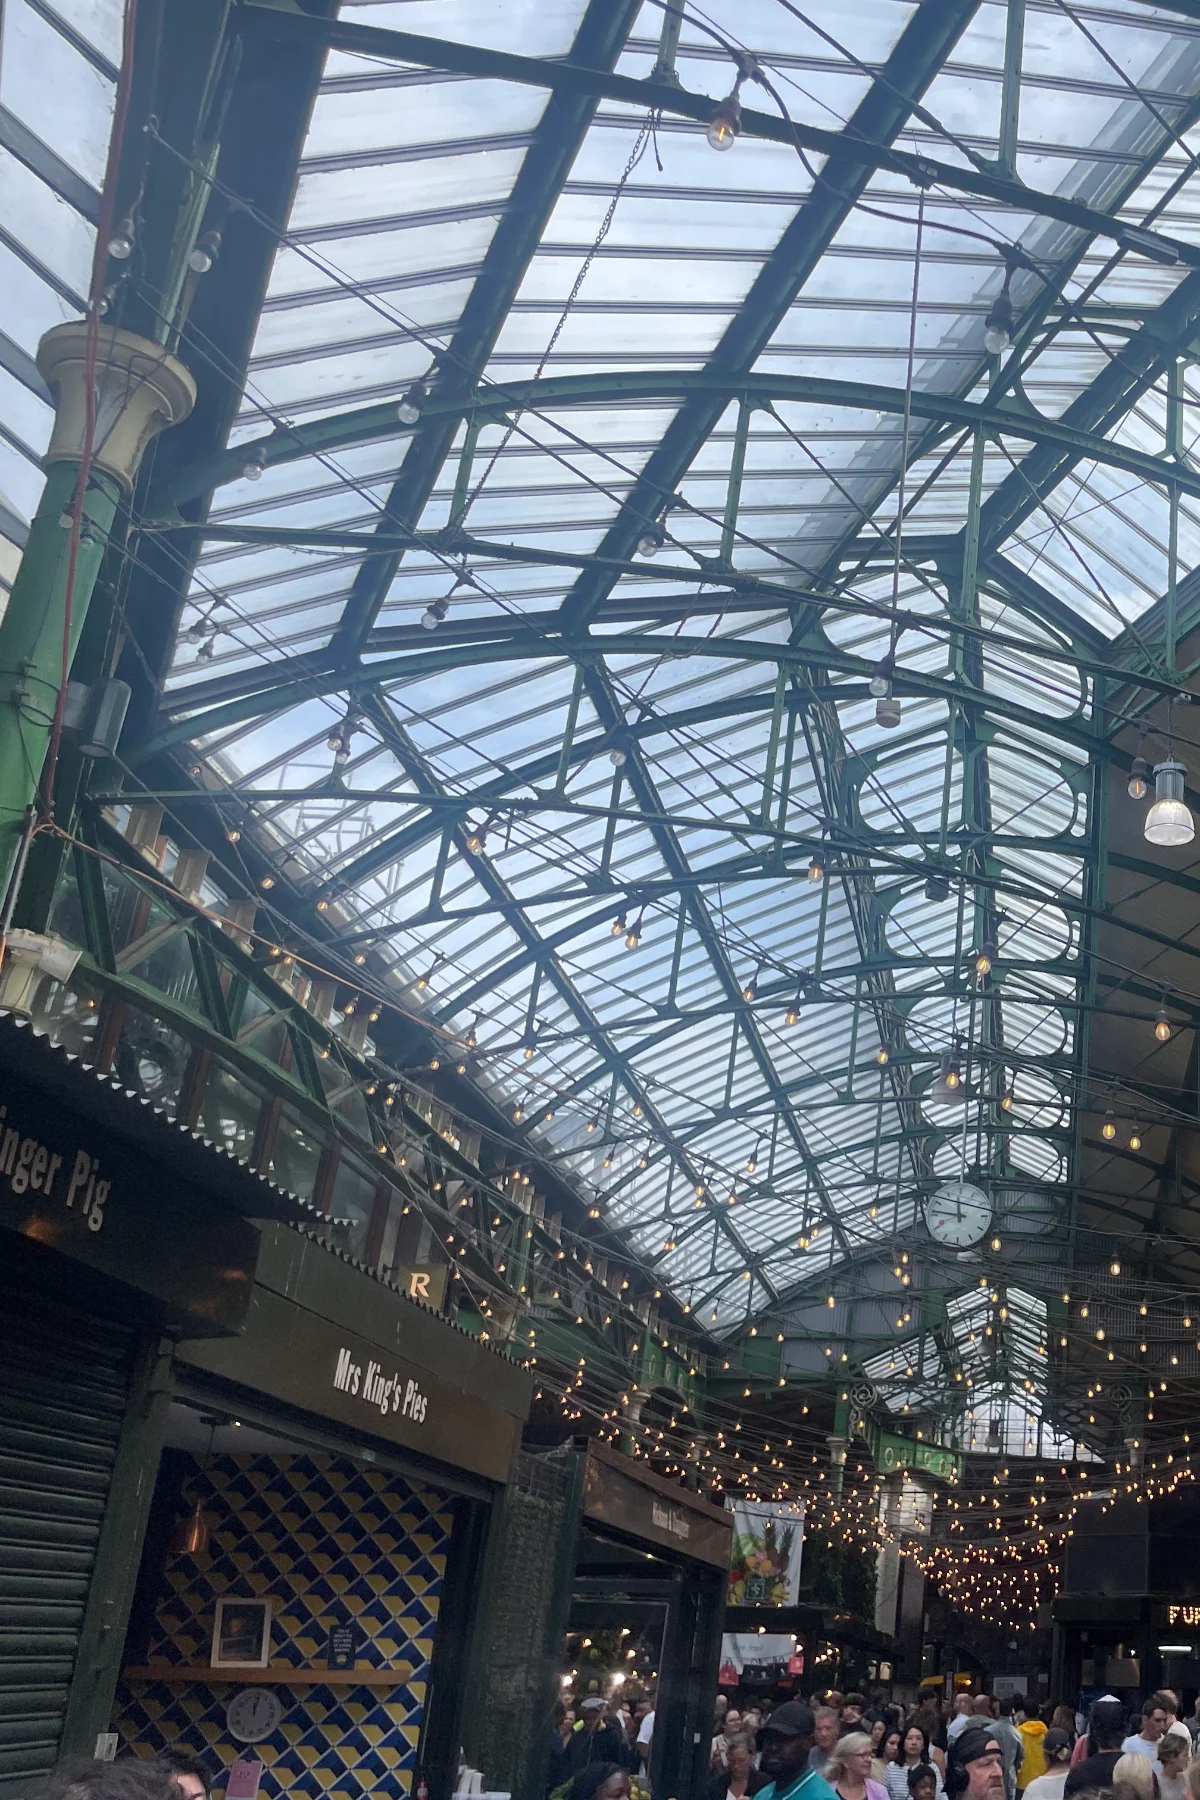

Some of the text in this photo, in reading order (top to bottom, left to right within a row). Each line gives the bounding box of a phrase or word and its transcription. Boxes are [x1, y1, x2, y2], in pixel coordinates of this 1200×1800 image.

[66, 1149, 111, 1232] Pig
[409, 1272, 431, 1297] R
[333, 1347, 428, 1423] Mrs King's Pies
